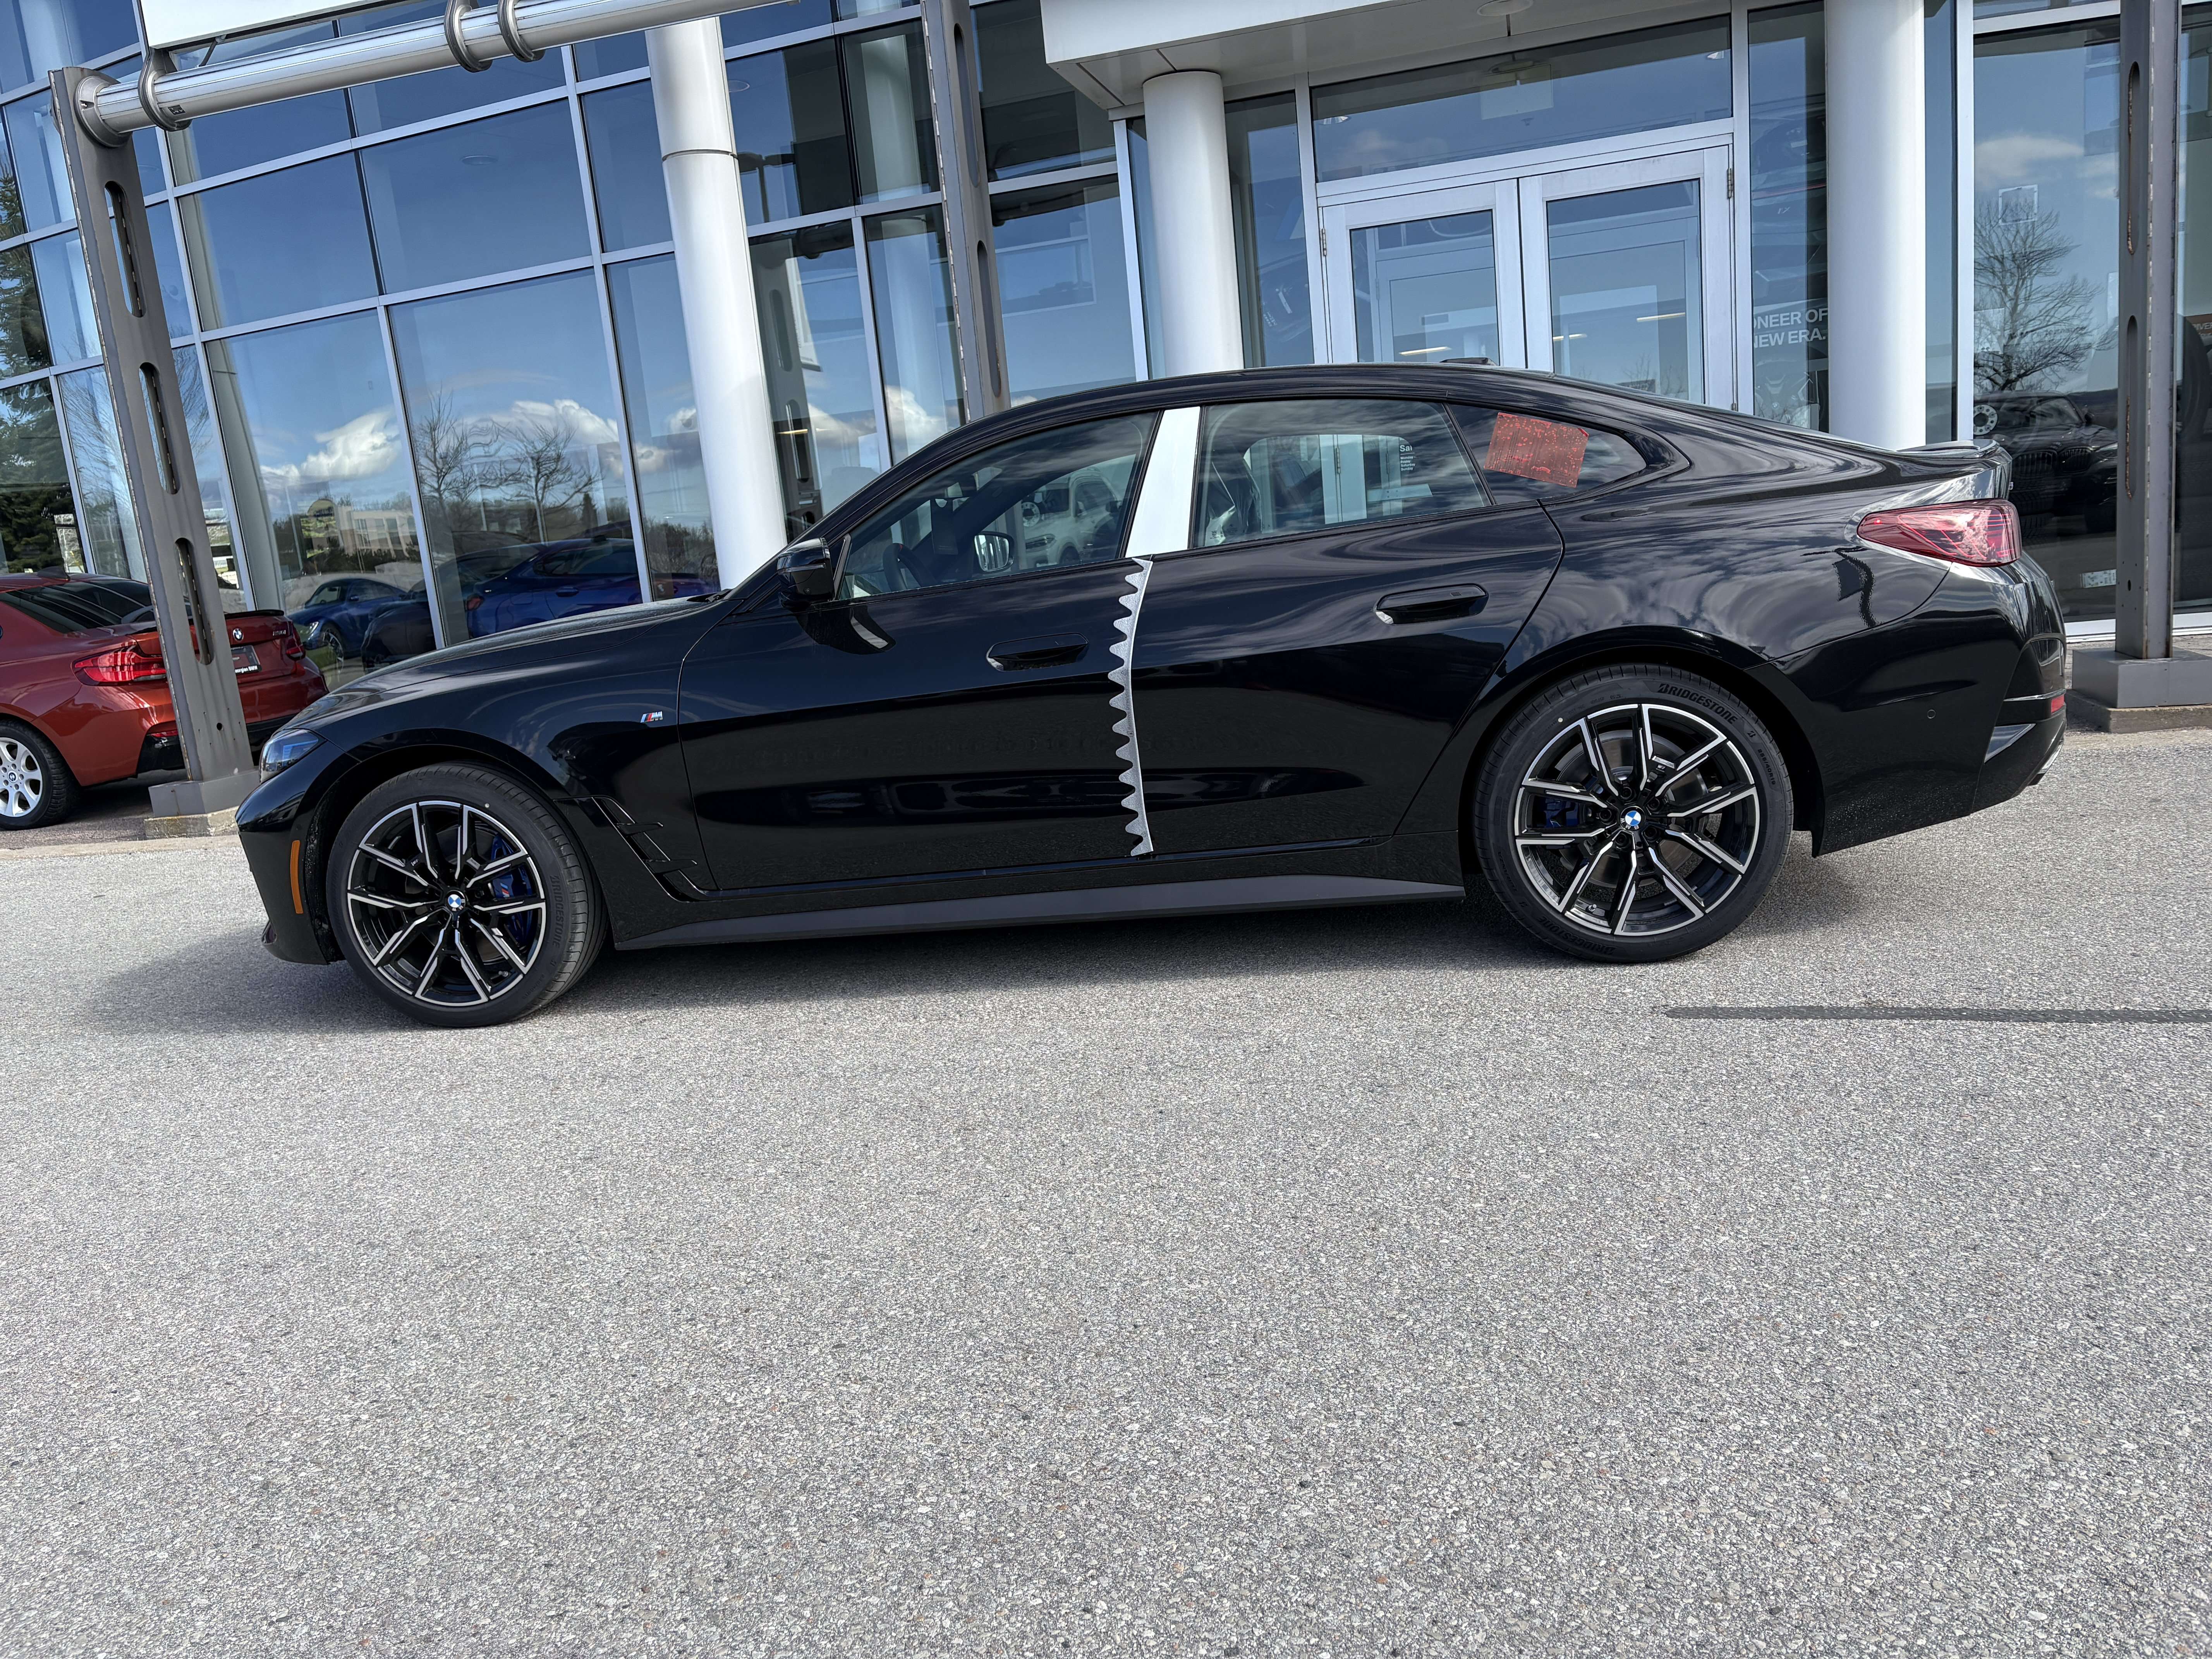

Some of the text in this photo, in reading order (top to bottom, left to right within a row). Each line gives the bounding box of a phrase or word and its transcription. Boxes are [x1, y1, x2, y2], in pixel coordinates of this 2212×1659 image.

[1754, 307, 1828, 329] NEER OF
[1788, 328, 1826, 344] ERA.
[1657, 683, 1738, 724] BRIDGESTONE
[550, 876, 564, 948] BRIDGESTONE
[1537, 916, 1617, 955] BRIDGESTONE
